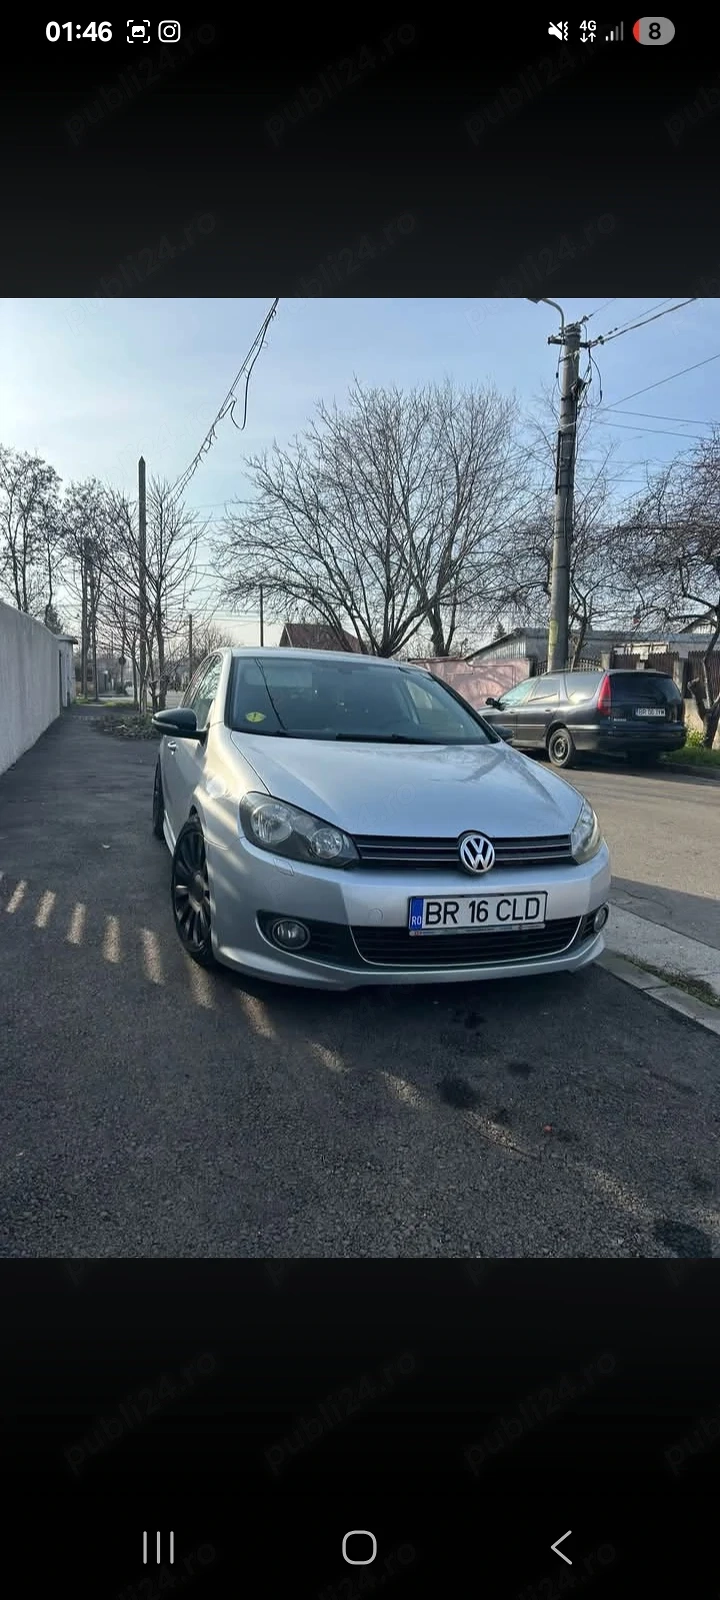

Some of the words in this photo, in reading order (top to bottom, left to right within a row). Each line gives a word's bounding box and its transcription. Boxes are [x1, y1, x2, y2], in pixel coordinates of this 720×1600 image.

[46, 21, 112, 42] 01:46
[579, 20, 597, 31] 4G
[648, 22, 661, 40] 8
[425, 901, 460, 925] BR
[468, 900, 489, 923] 16
[496, 897, 541, 921] CLD
[411, 916, 422, 926] RO
